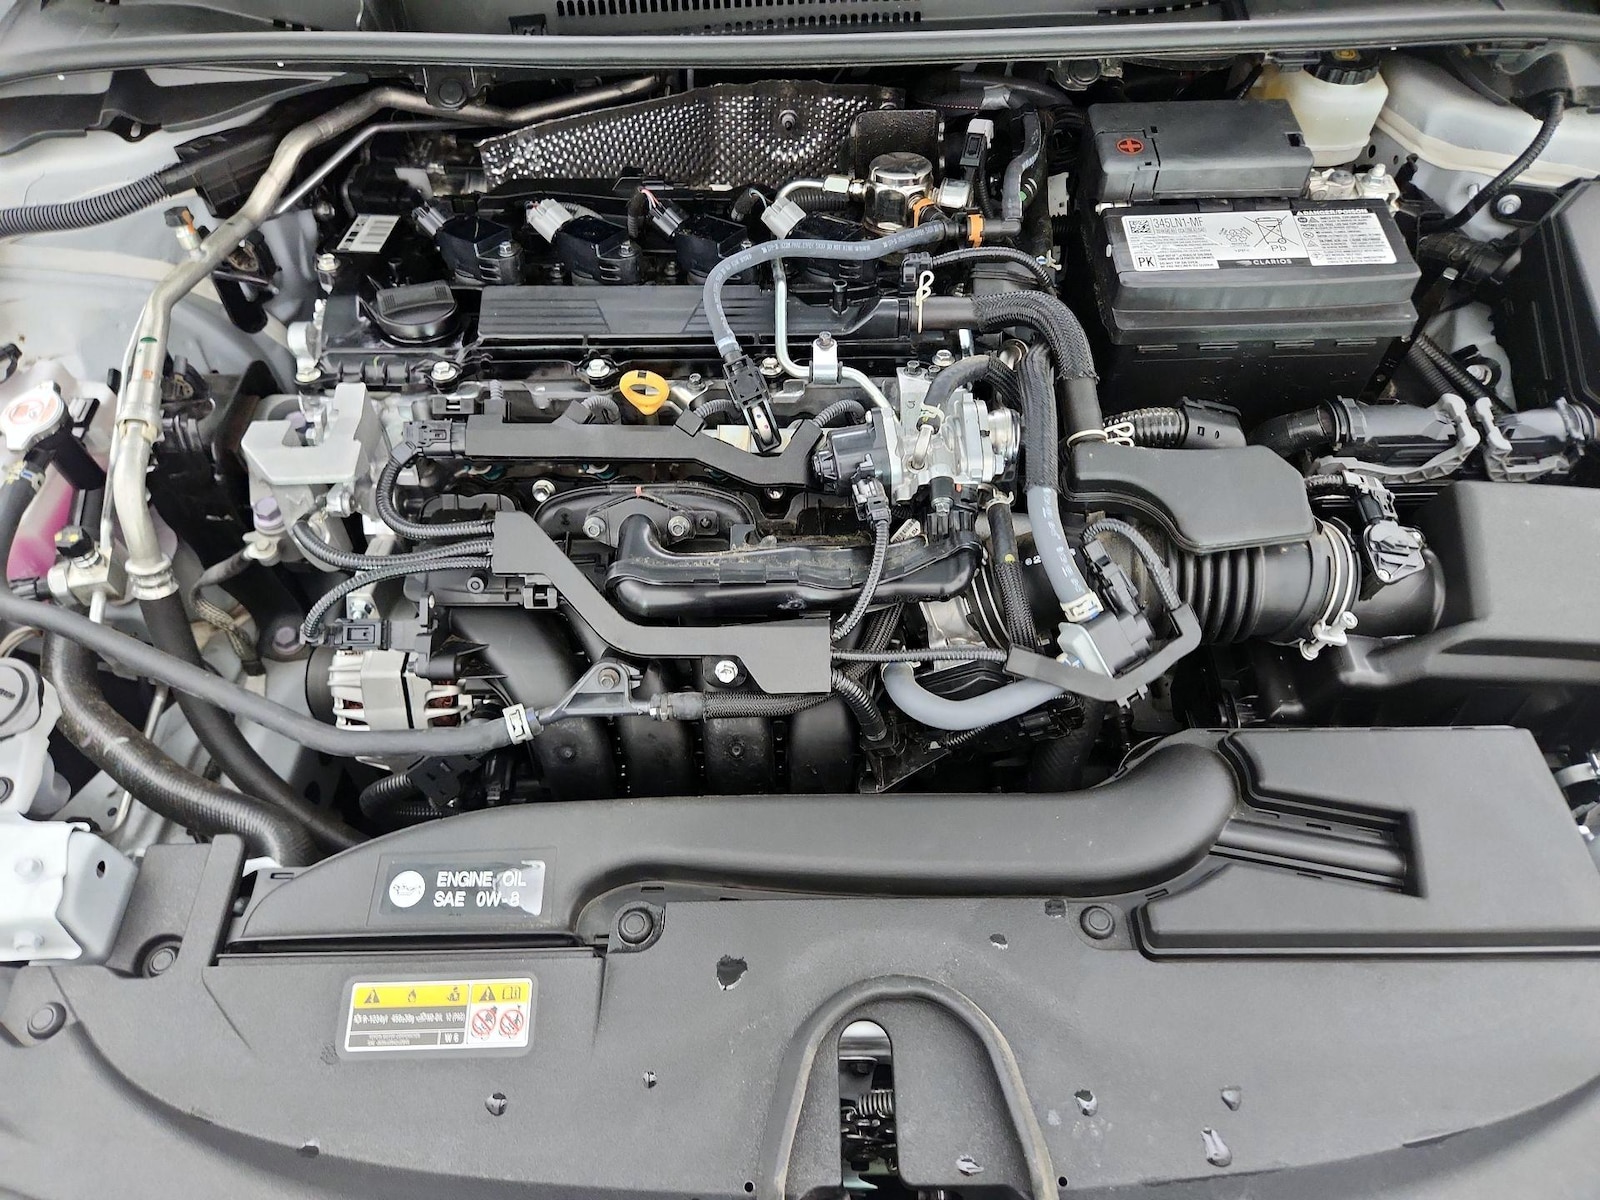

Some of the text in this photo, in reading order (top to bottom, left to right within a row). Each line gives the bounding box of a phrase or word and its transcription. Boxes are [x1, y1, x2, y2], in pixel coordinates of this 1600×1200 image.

[1270, 244, 1287, 252] Pb
[1138, 256, 1155, 267] PK
[436, 870, 527, 887] ENGINE OIL
[433, 891, 467, 908] SAE
